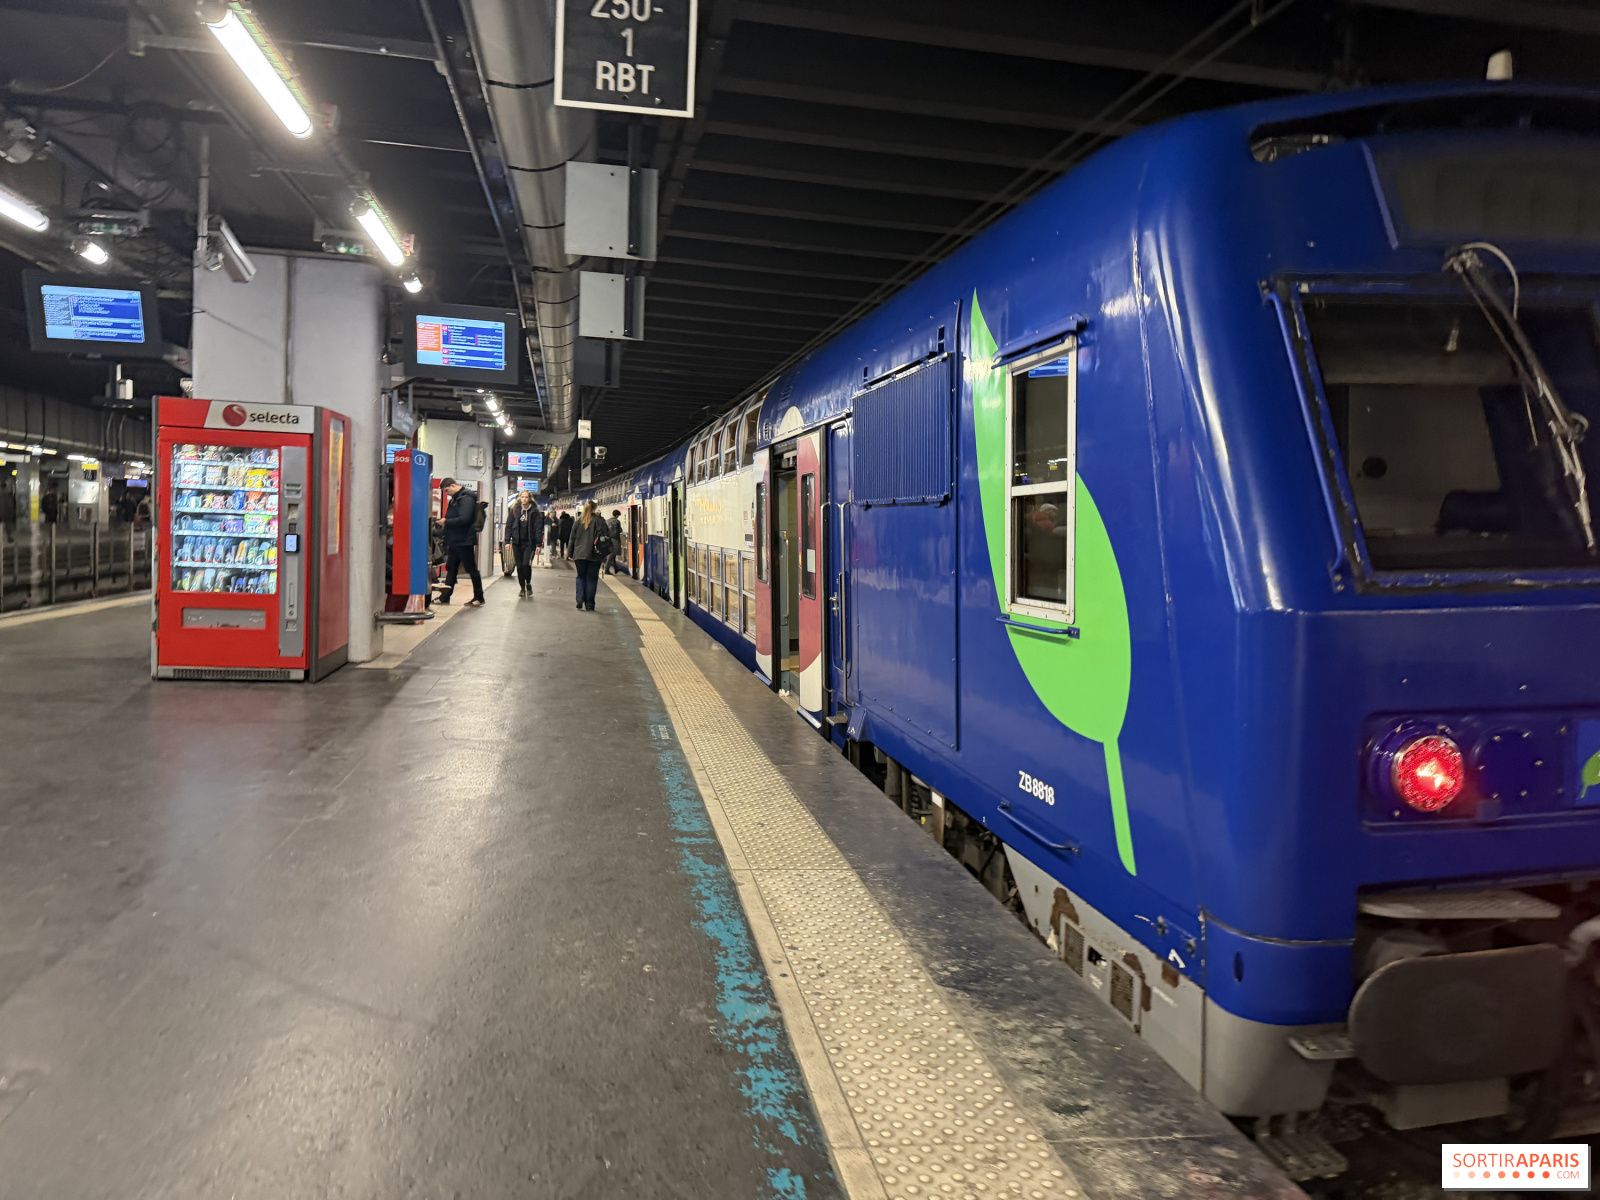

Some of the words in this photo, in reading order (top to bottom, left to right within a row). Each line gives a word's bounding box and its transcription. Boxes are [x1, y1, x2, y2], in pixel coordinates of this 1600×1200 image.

[620, 27, 634, 57] 1
[595, 60, 656, 95] RBT
[249, 411, 300, 425] selecta
[394, 455, 410, 463] SOS
